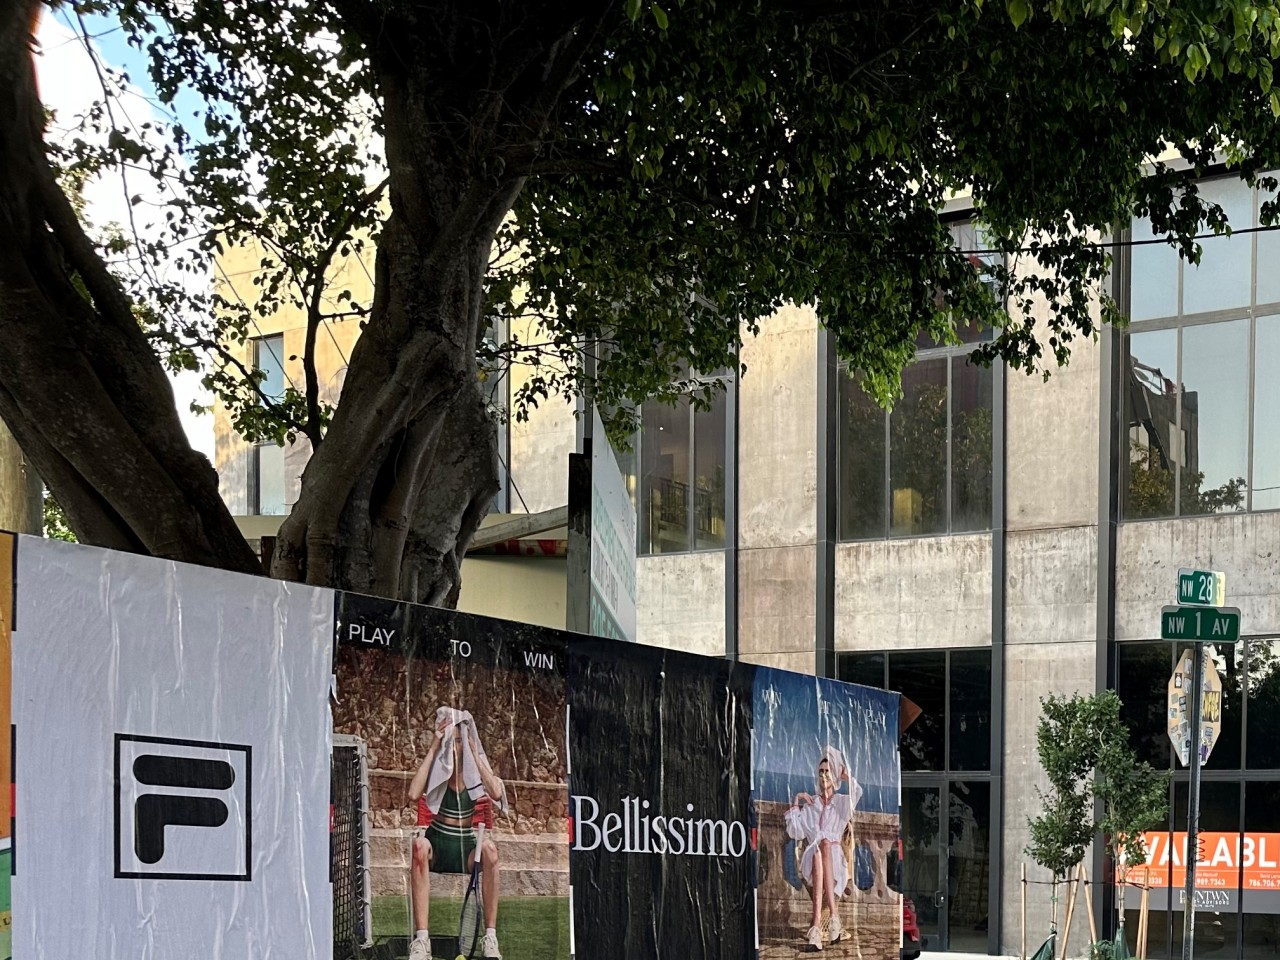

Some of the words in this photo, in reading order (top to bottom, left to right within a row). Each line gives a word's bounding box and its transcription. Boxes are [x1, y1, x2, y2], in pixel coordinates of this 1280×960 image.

[1181, 579, 1194, 598] NW
[1198, 575, 1213, 601] 28
[1168, 617, 1186, 634] NW
[1195, 611, 1201, 637] 1
[1212, 618, 1230, 636] AV
[349, 624, 396, 646] PLAY
[449, 639, 472, 658] TO
[523, 650, 554, 670] WIN
[571, 795, 747, 858] Bellissimo
